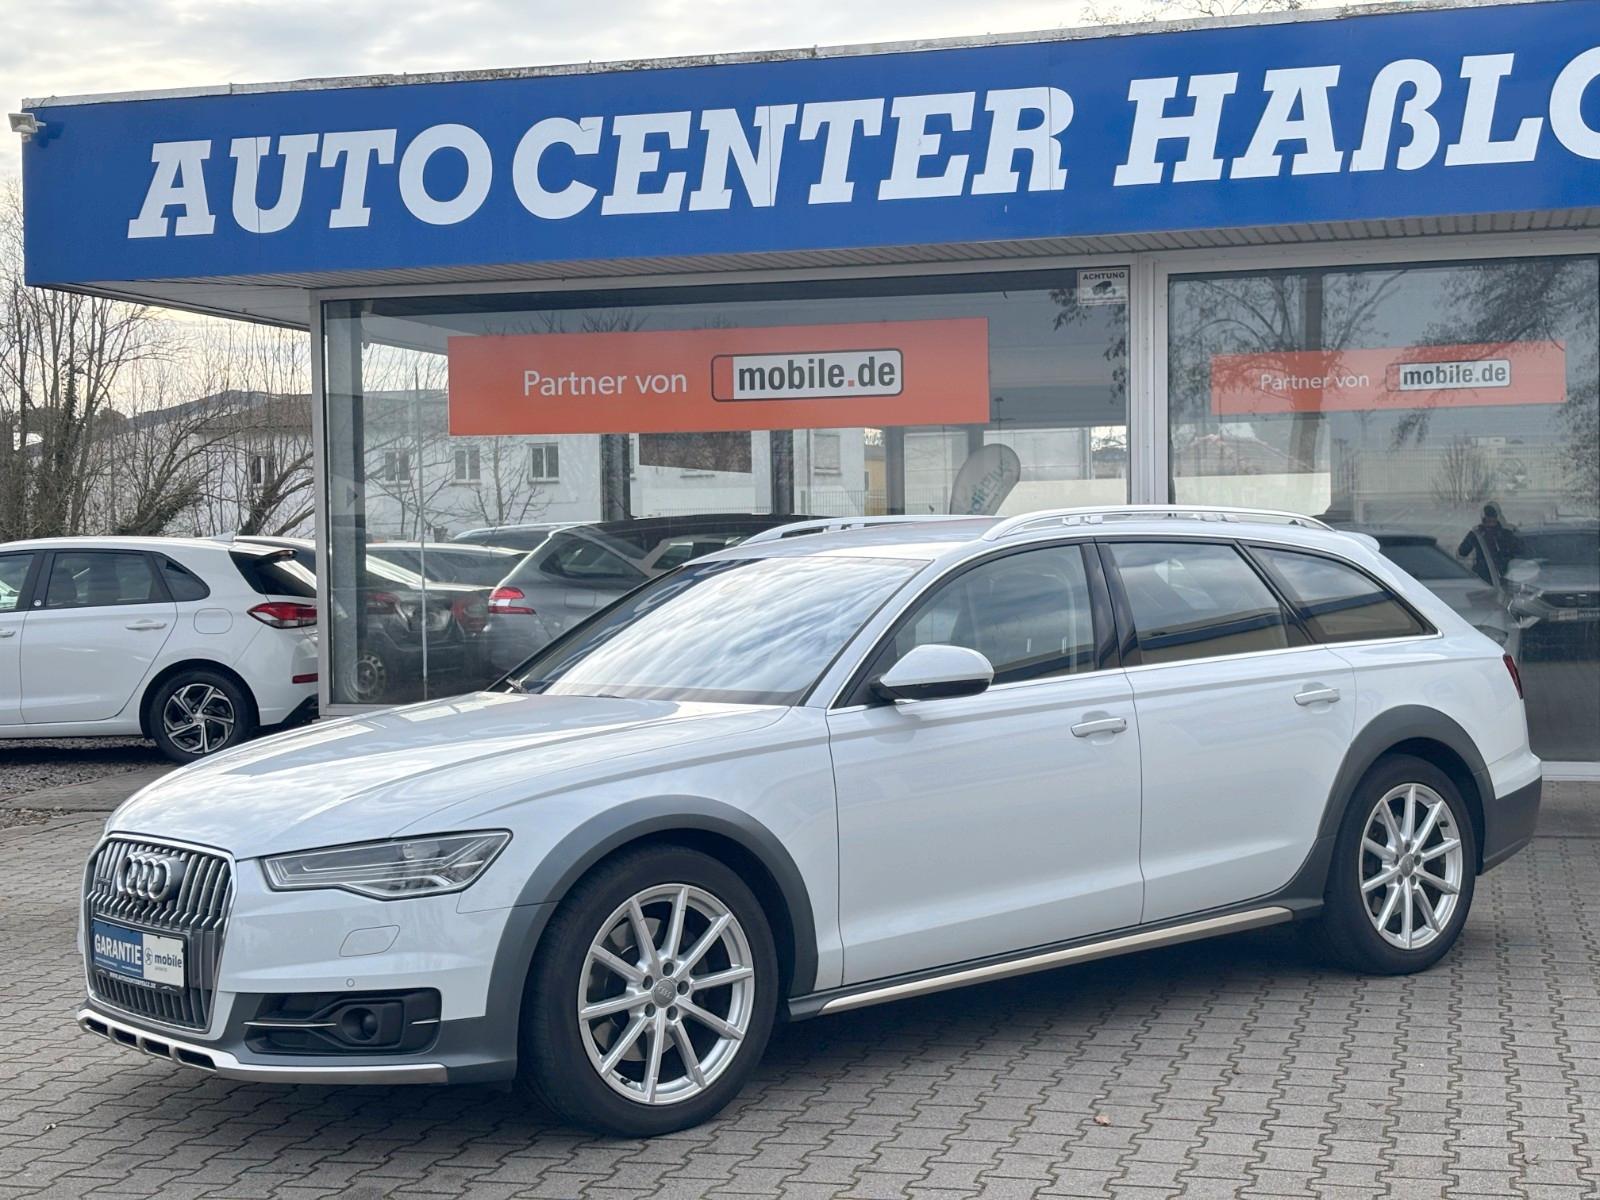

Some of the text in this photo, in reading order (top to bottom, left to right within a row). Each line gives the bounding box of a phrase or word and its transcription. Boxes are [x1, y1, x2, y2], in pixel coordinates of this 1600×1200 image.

[1083, 272, 1125, 280] ACHTUNG
[523, 356, 896, 397] Partner von mobile.de
[1260, 364, 1506, 391] Partner von mobile.de
[94, 933, 142, 966] GARANTIE
[154, 952, 183, 968] mobile
